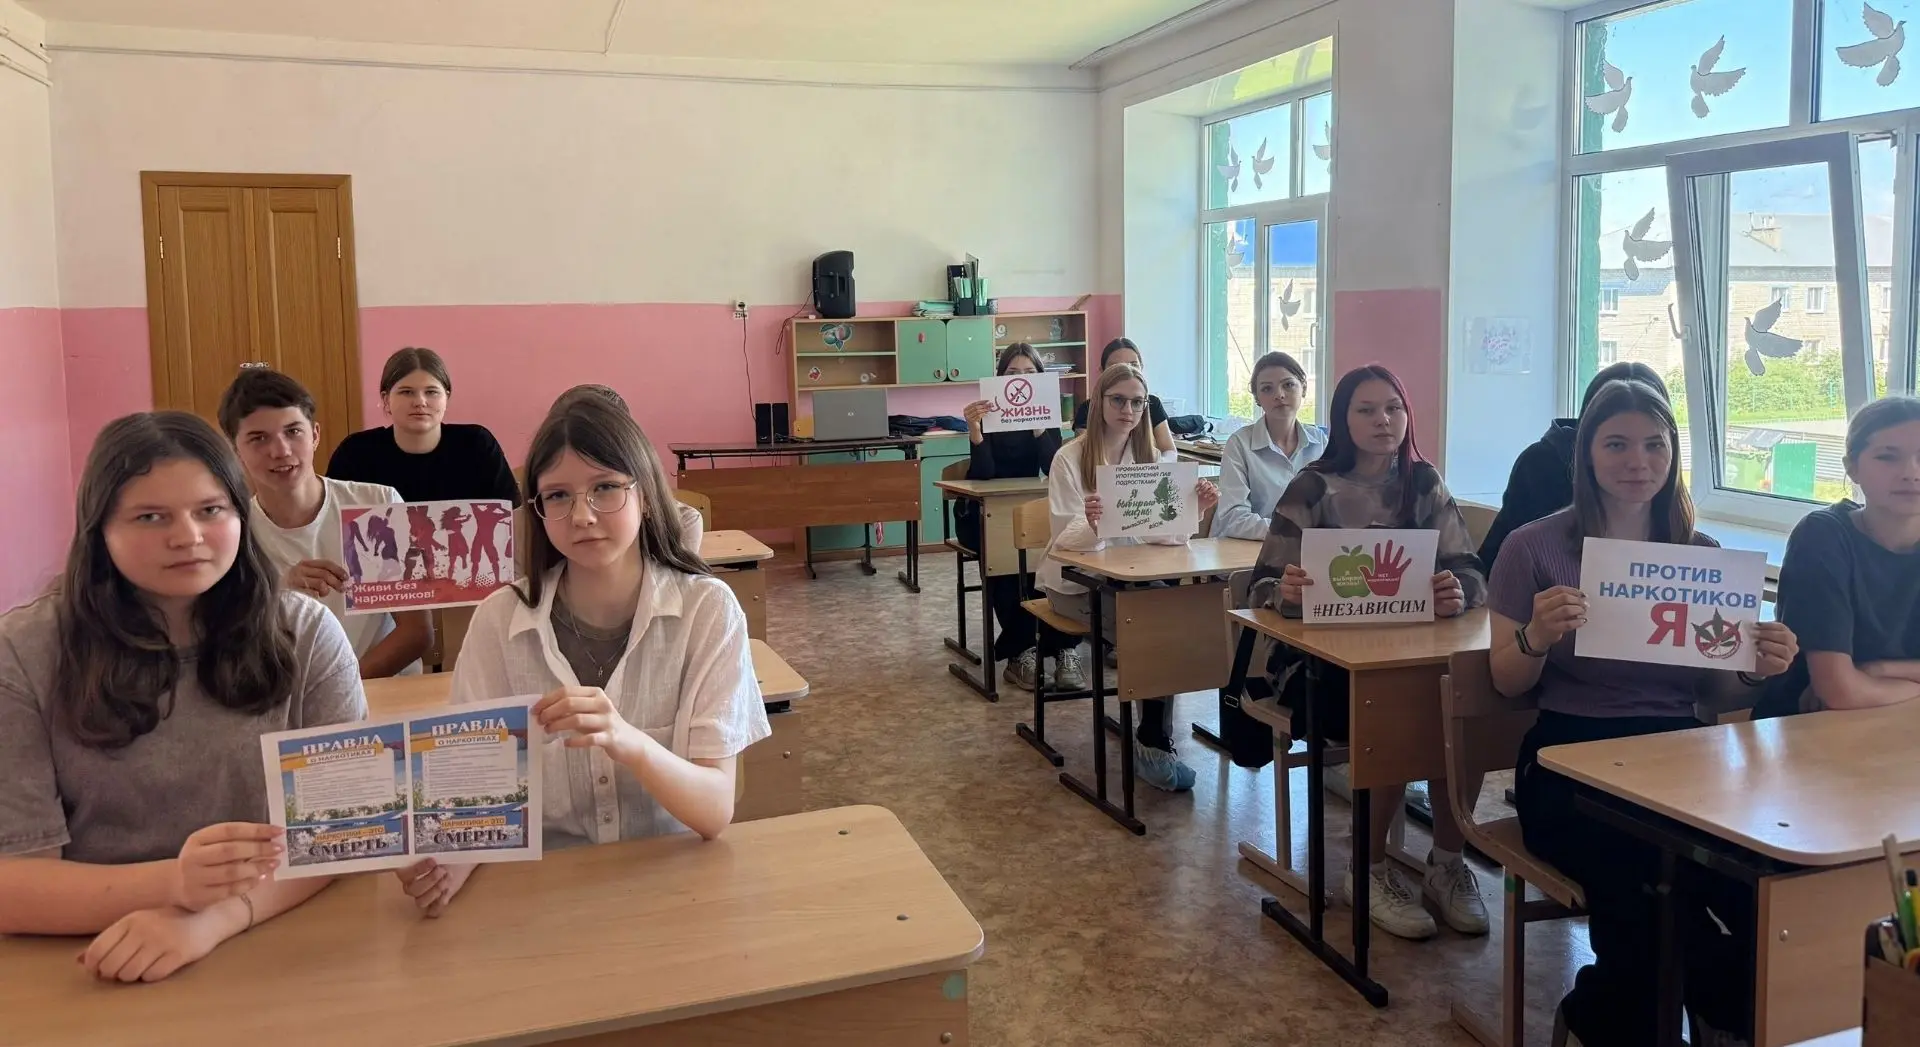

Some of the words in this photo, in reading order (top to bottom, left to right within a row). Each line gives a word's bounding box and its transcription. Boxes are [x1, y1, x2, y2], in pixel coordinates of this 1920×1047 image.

[1000, 405, 1051, 418] ЖИЗНЬ
[1013, 415, 1051, 423] наркотиков
[1629, 562, 1722, 584] ПРОТИВ
[354, 582, 392, 593] Живи
[394, 581, 417, 591] без
[1599, 581, 1757, 609] НАРКОТИКОВ
[354, 590, 435, 604] наркотиков!
[1313, 600, 1426, 617] #НЕЗАВИСИМ
[1646, 602, 1689, 647] Я
[431, 716, 509, 737] ПРАВДА
[302, 734, 383, 756] ПРАВДА
[446, 735, 497, 745] НАРКОТИКАХ
[318, 750, 373, 762] НАРКОТИКАХ
[433, 829, 508, 845] СМЕРТЬ
[308, 838, 387, 856] СМЕРТЬ
